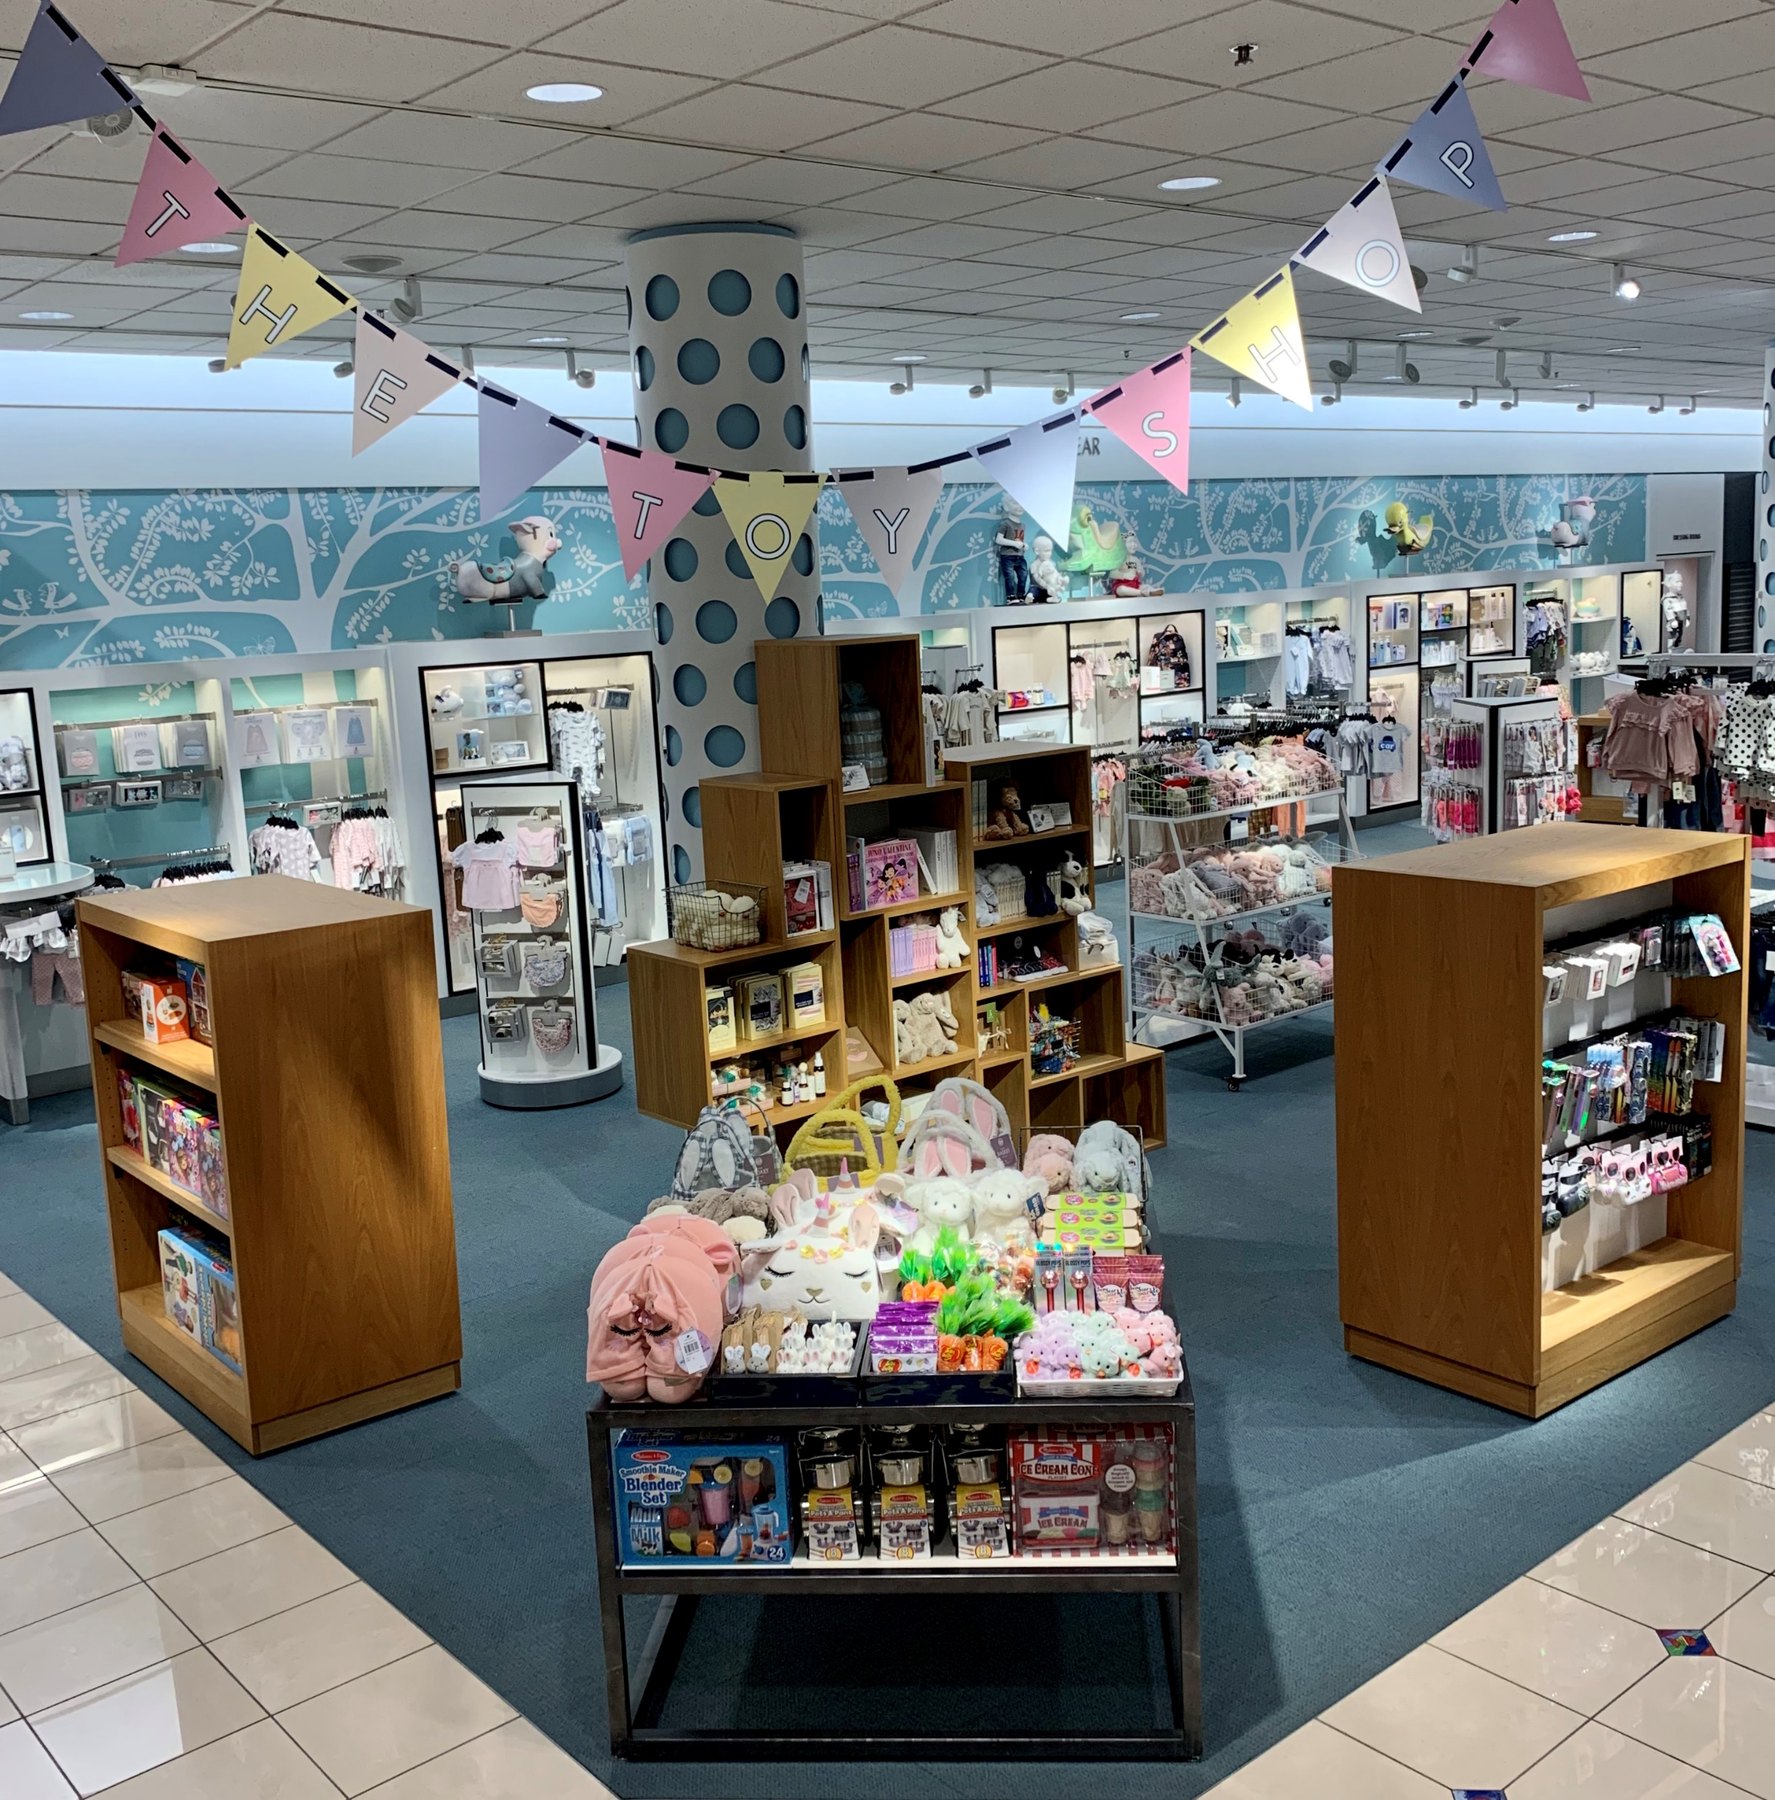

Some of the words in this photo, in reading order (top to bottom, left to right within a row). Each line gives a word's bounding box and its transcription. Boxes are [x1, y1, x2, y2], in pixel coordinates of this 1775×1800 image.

[632, 491, 910, 560] TOY
[620, 1464, 657, 1478] Smoothie
[658, 1465, 686, 1478] Maker
[1034, 1463, 1069, 1475] CREAM
[626, 1478, 682, 1491] Blender
[642, 1492, 666, 1504] Set
[1037, 1518, 1053, 1529] ICE
[1054, 1516, 1088, 1529] CREAM
[631, 1526, 661, 1544] Milk
[770, 1547, 783, 1558] 24
